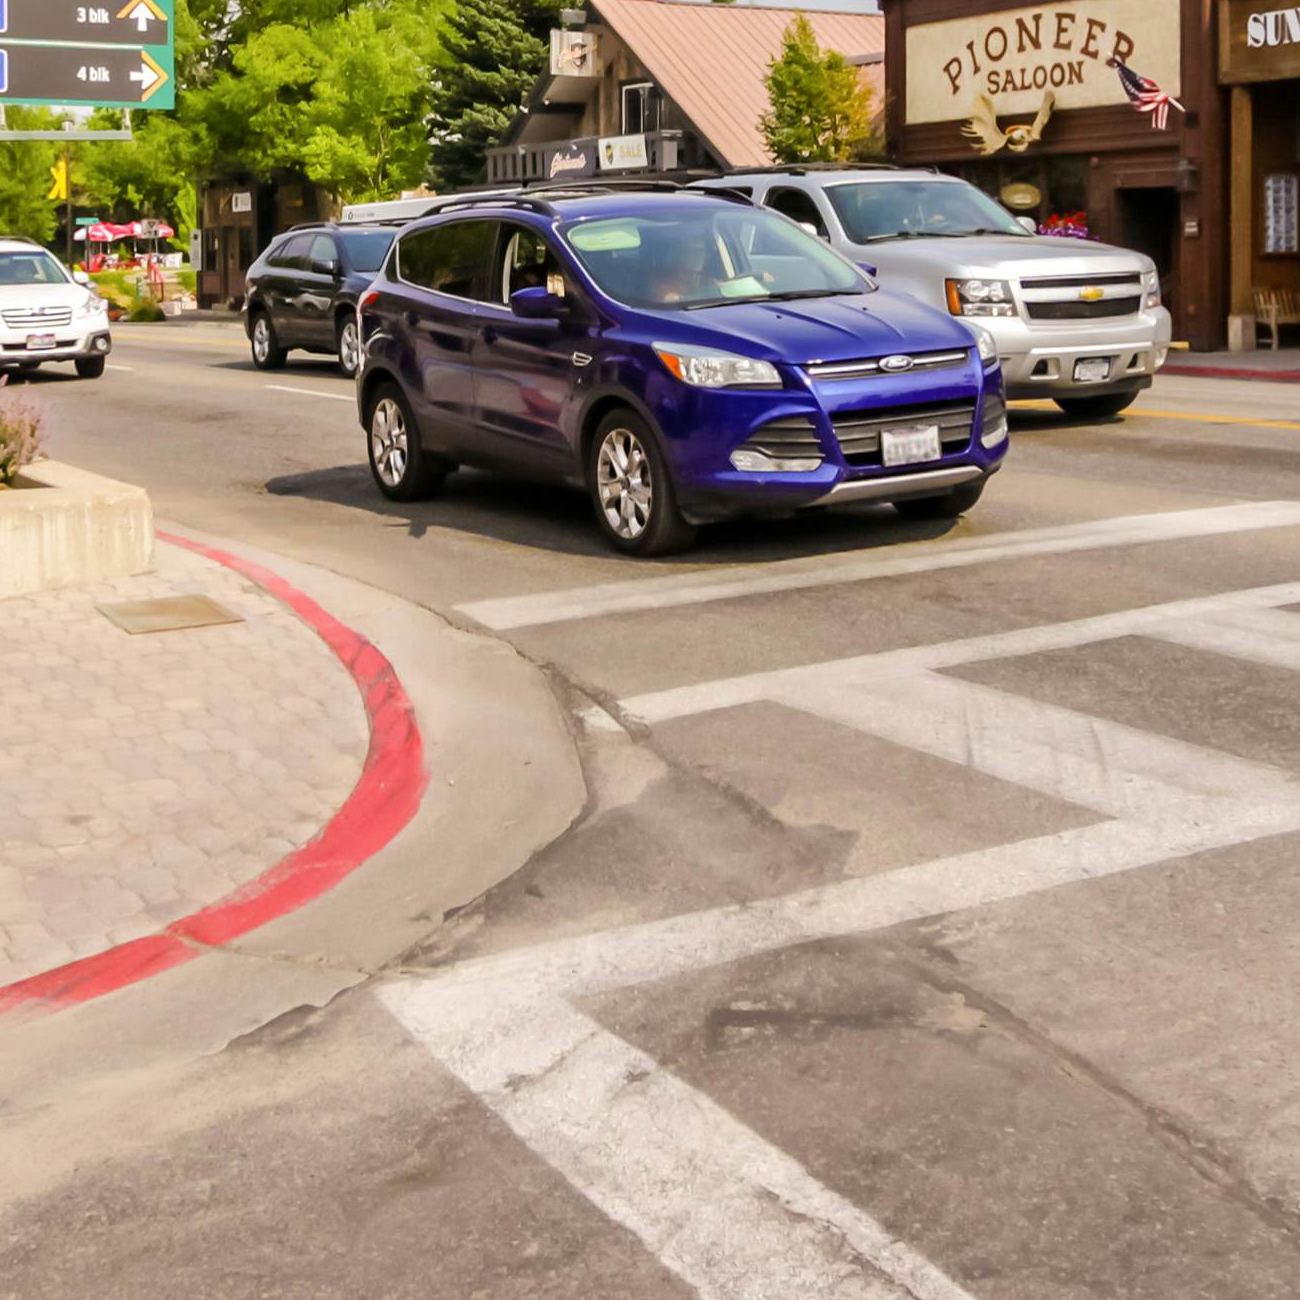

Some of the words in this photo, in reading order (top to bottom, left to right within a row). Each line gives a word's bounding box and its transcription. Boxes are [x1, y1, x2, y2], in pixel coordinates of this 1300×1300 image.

[76, 7, 87, 23] 3
[88, 8, 110, 24] blk
[942, 12, 1135, 96] PIONEER
[76, 66, 87, 82] 4
[89, 66, 111, 83] blk
[986, 60, 1085, 96] SALOON
